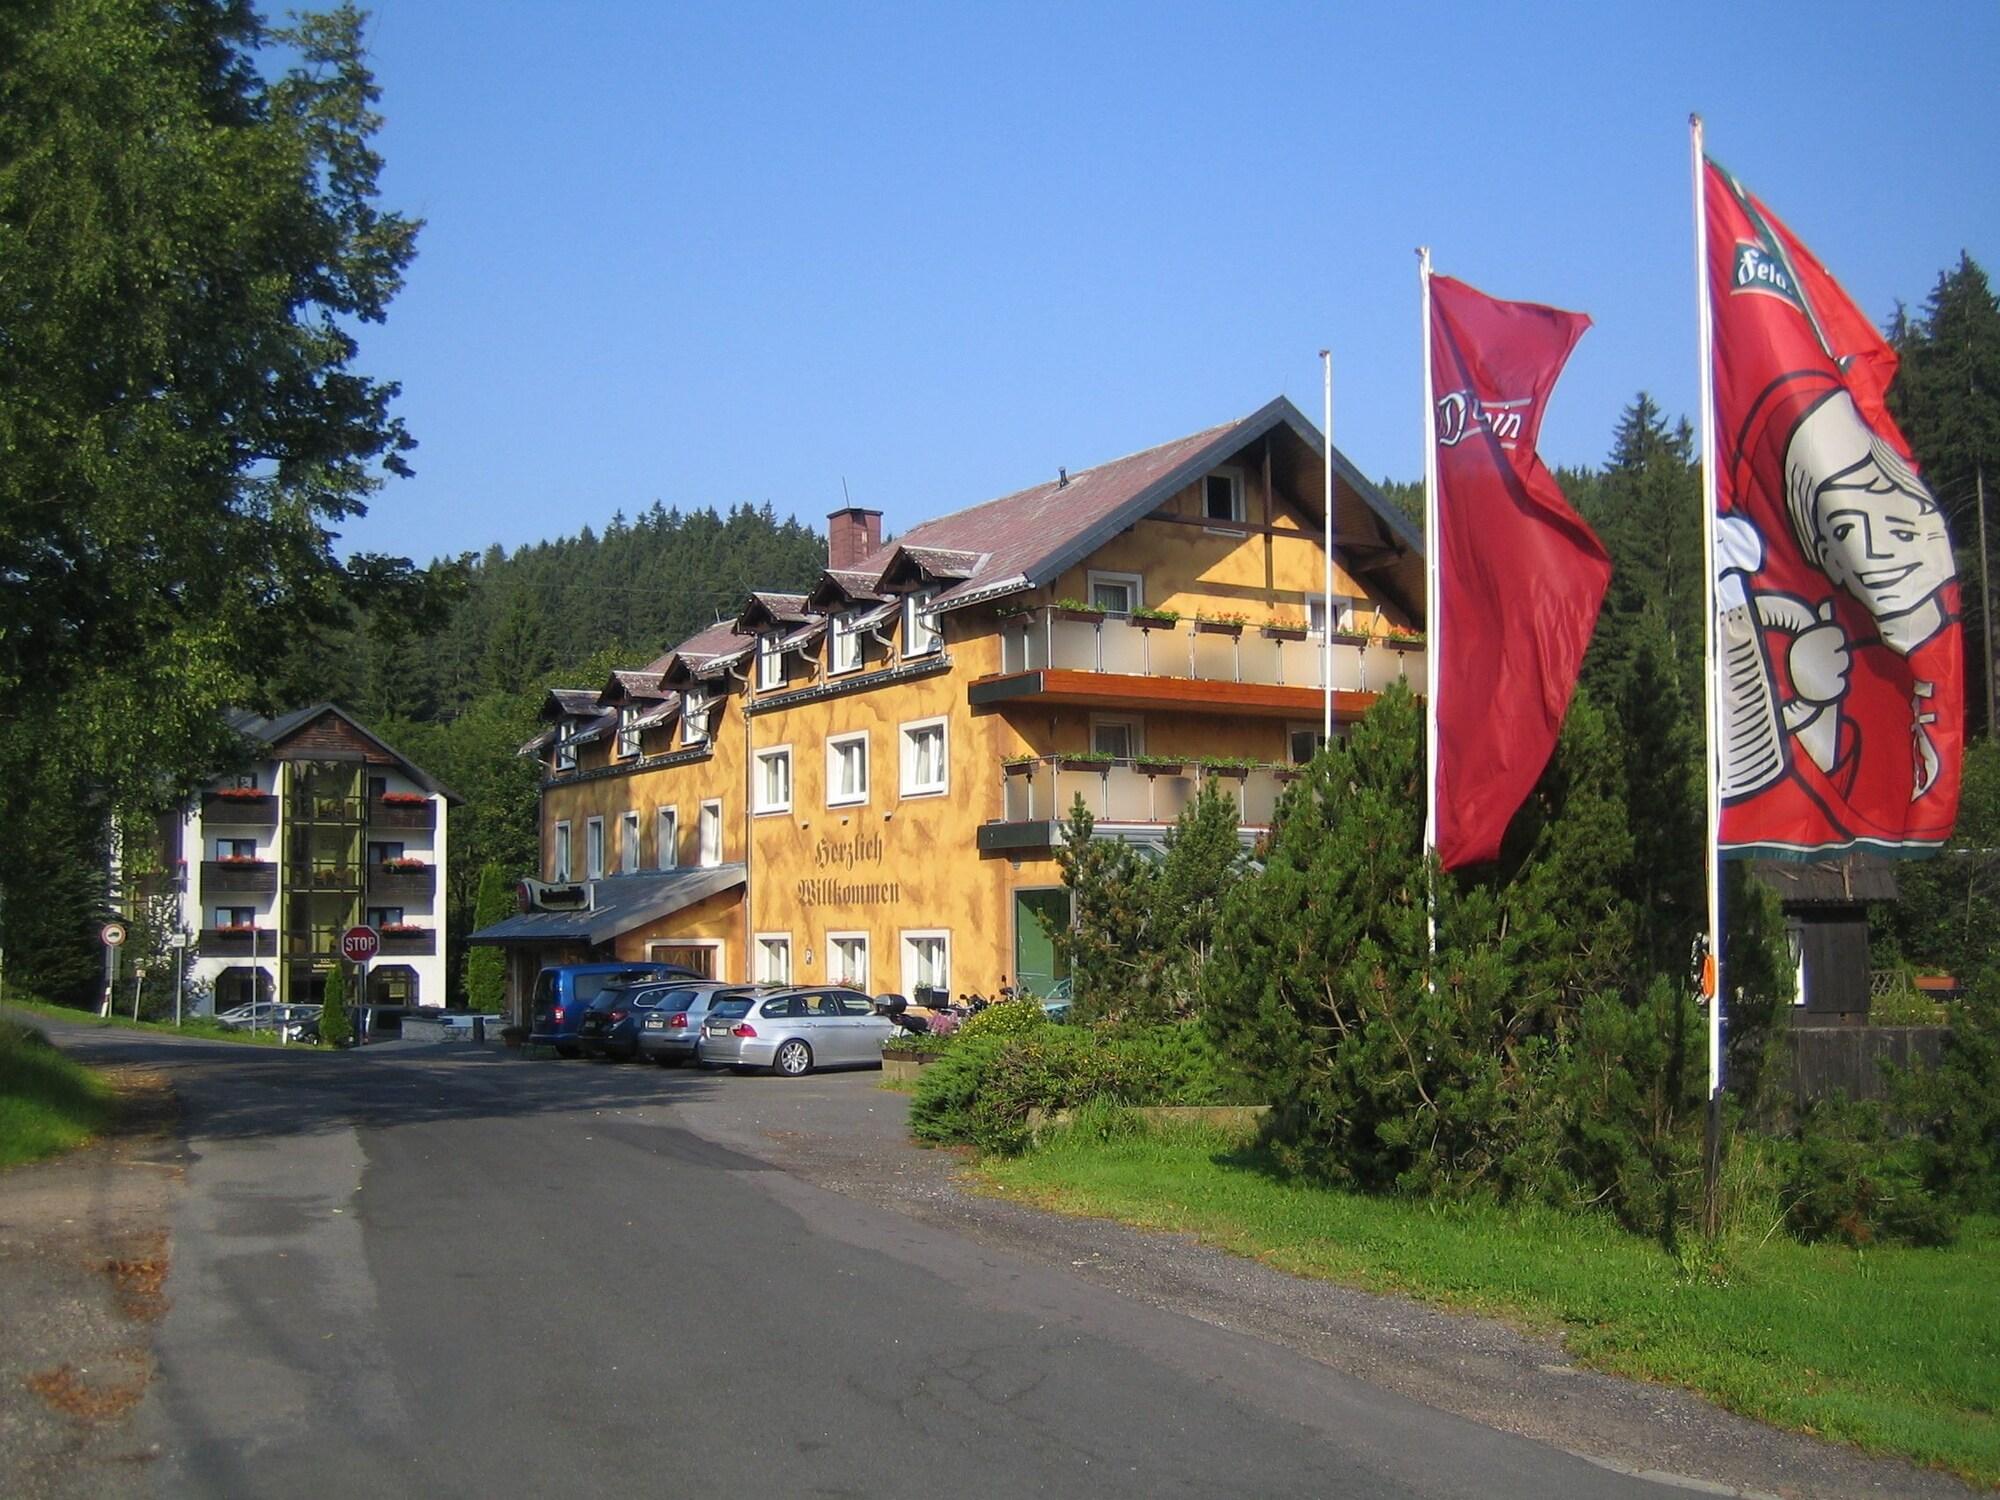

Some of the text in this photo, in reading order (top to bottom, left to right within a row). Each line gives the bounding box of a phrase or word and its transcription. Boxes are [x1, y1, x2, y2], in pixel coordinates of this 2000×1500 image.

[815, 832, 882, 872] Herzlich
[798, 878, 900, 906] Willkommen
[345, 936, 376, 952] STOP
